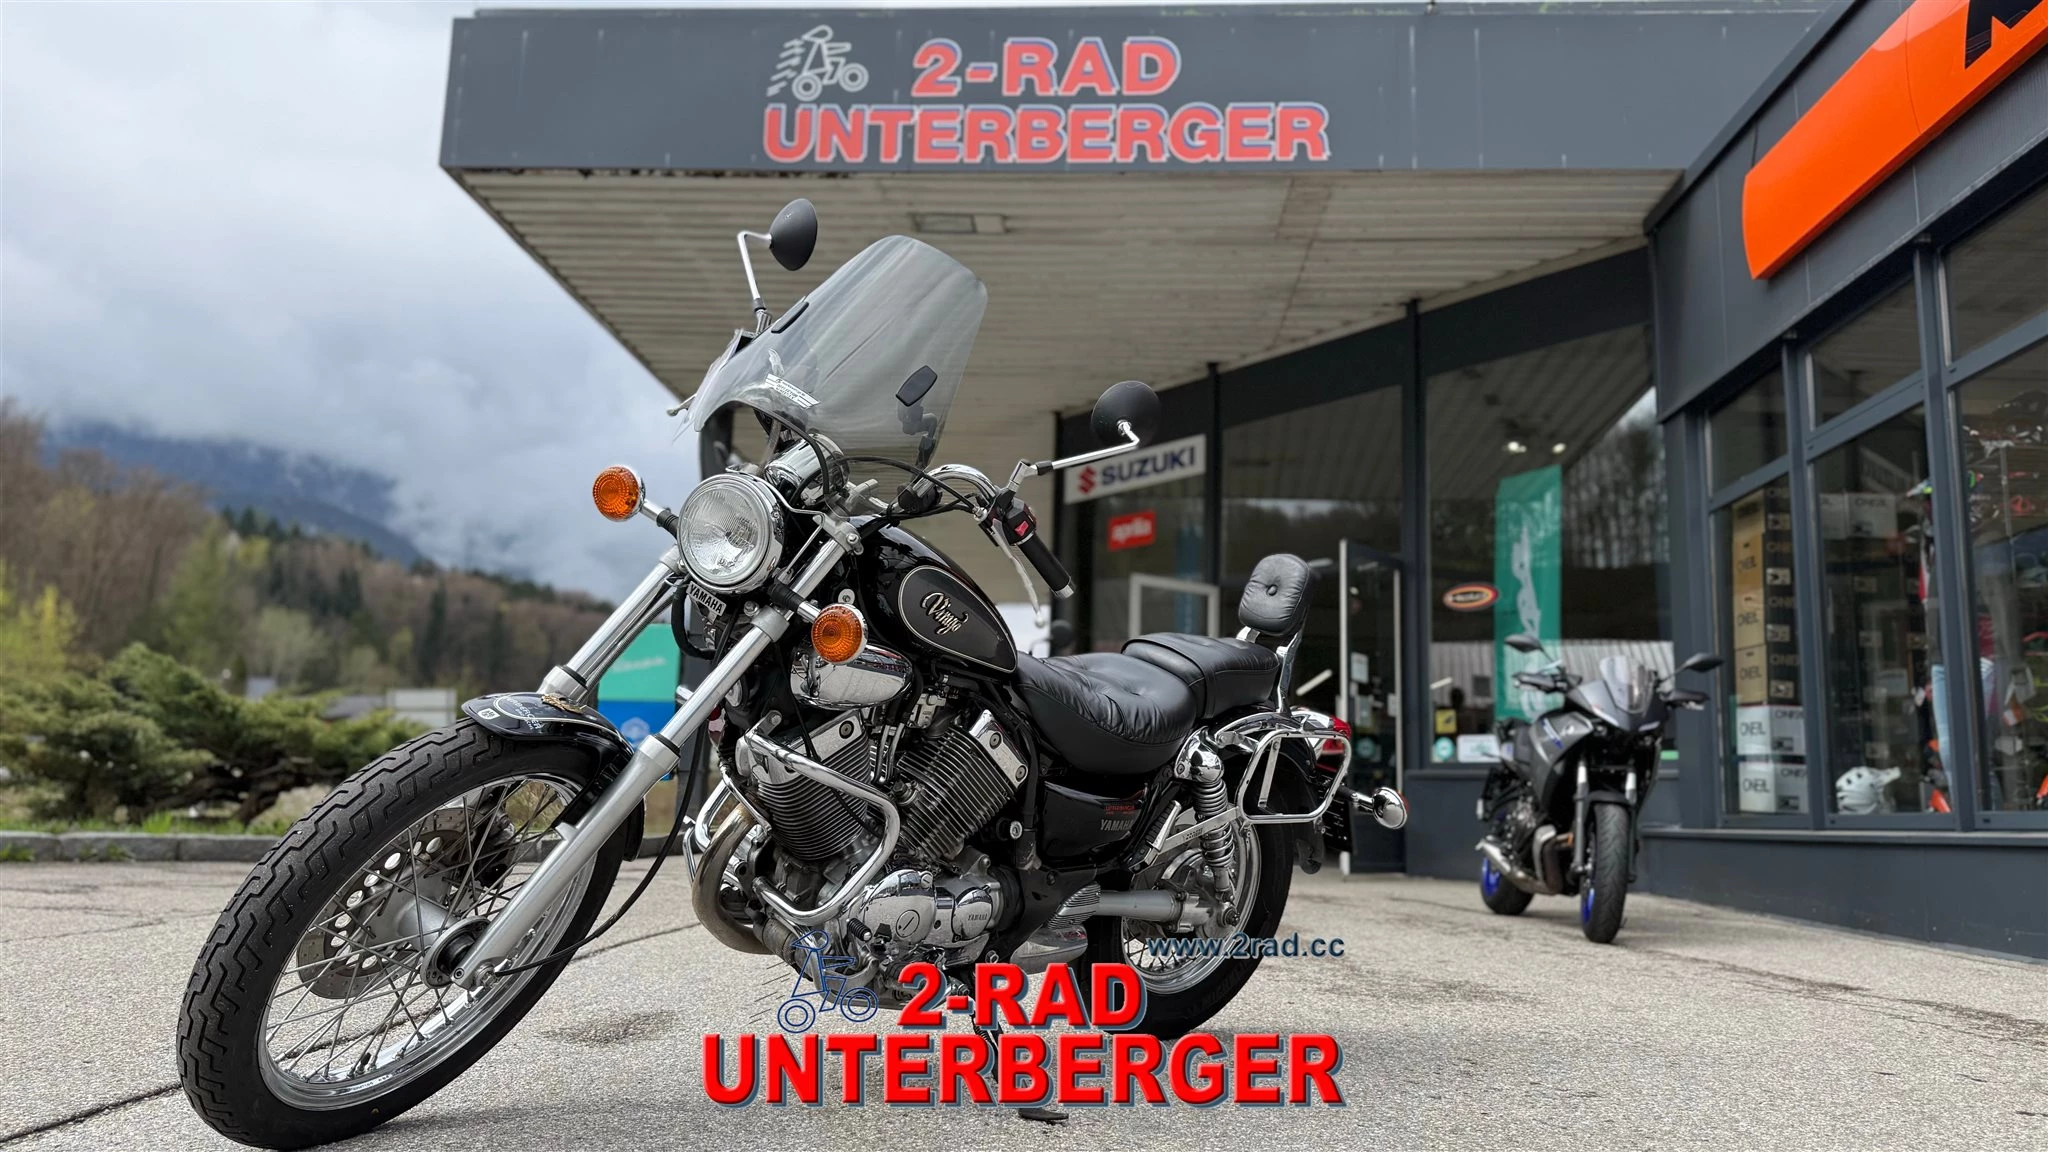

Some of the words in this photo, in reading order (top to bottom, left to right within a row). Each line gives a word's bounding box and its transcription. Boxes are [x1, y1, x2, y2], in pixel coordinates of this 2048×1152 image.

[912, 36, 1182, 97] 2-RAD
[763, 102, 1331, 164] UNTERBERGER
[1102, 447, 1196, 486] SUZUKI
[688, 583, 723, 616] YAMAHA
